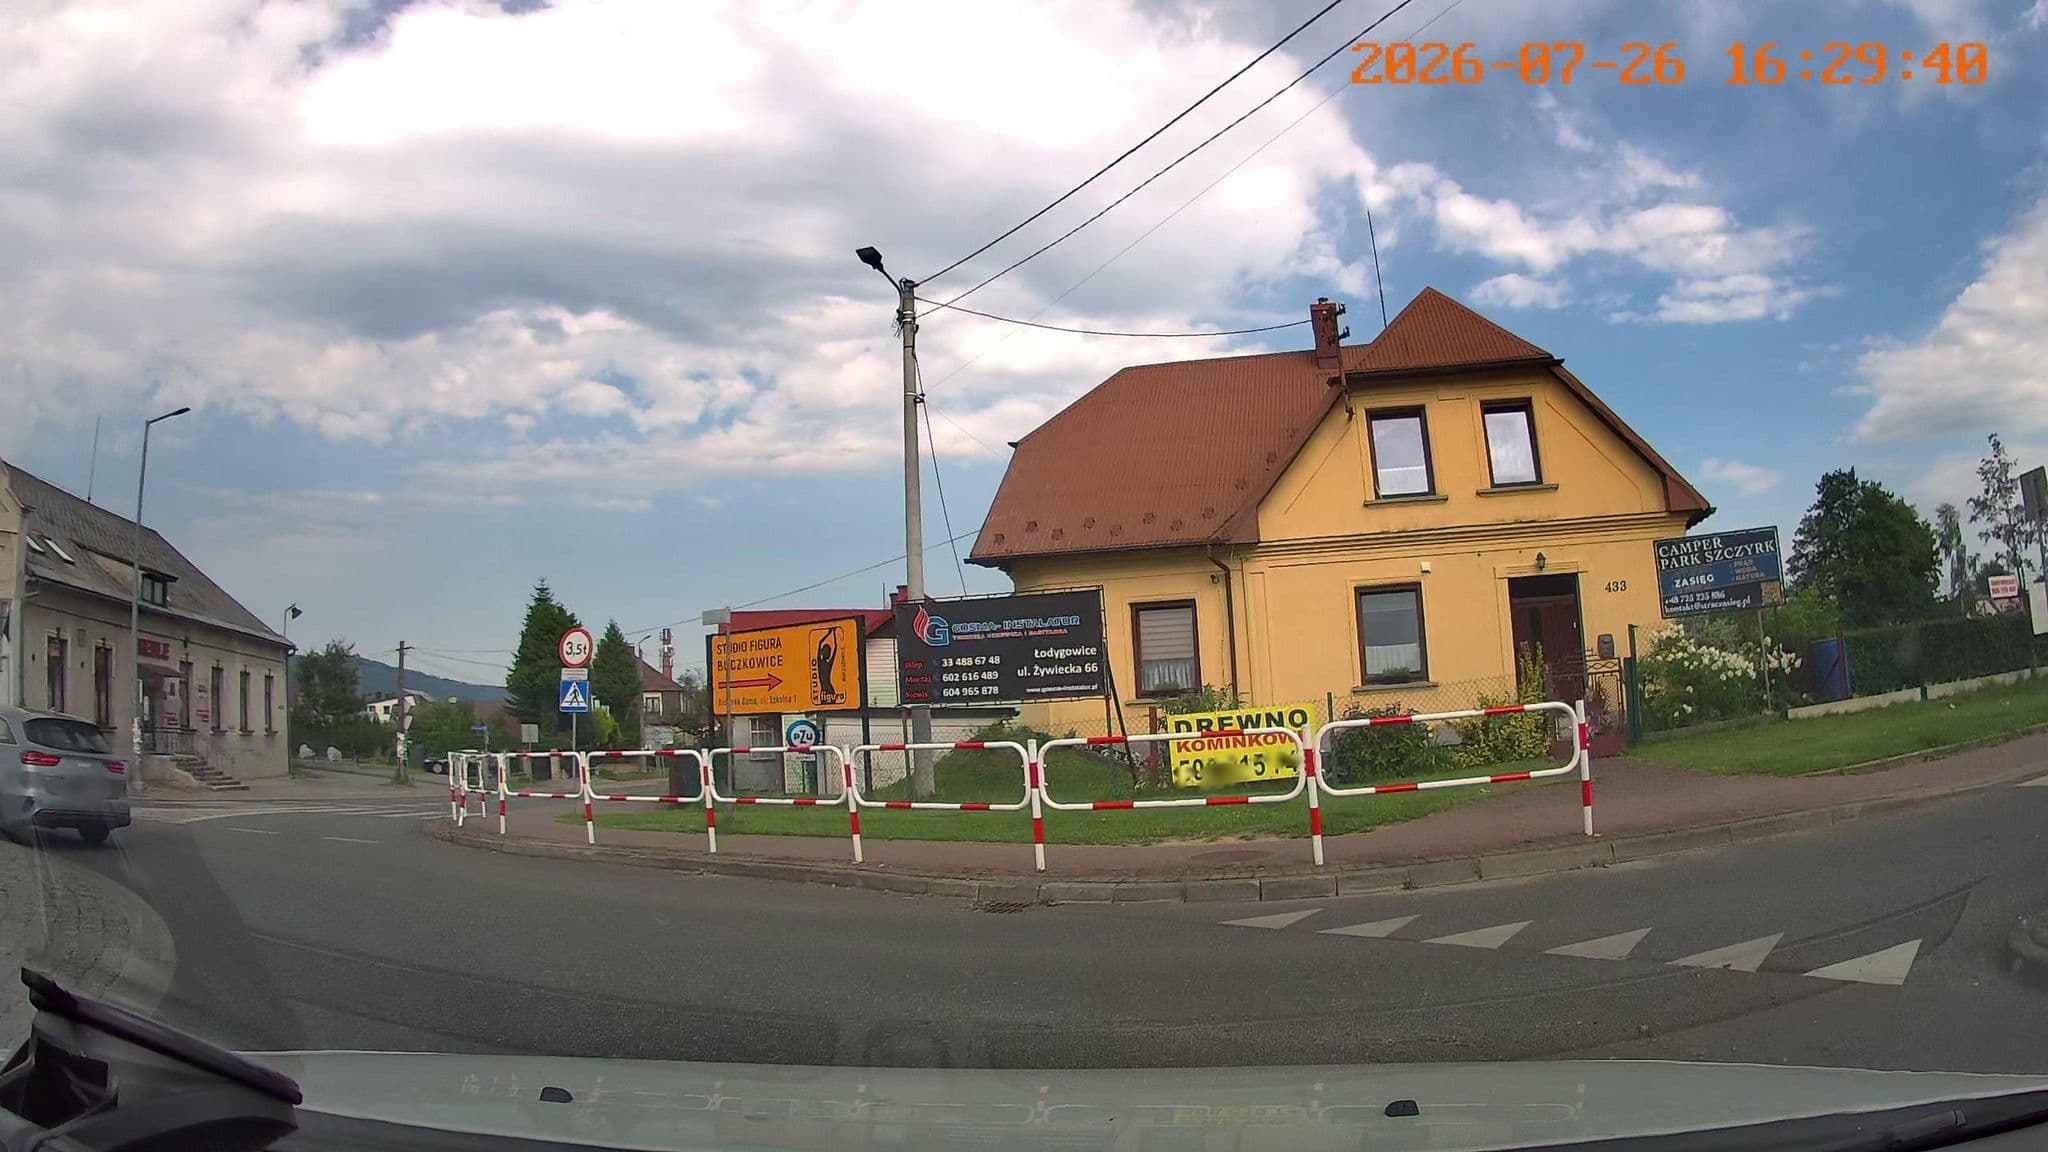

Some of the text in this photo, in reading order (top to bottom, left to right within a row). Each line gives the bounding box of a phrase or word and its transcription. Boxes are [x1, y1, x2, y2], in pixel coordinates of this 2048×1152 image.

[1659, 537, 1722, 558] CAMPER
[1660, 540, 1776, 570] PARK SZCZYRK
[1605, 580, 1627, 592] 433
[750, 637, 782, 651] FIGURA
[1034, 645, 1097, 659] Łodygowice
[941, 658, 953, 667] 33
[955, 657, 973, 666] 488
[974, 656, 986, 665] 67
[988, 656, 1000, 664] 48
[942, 673, 960, 682] 602
[961, 672, 979, 681] 616
[981, 671, 999, 679] 489
[1017, 663, 1098, 677] ul. Żywiecka 66
[811, 658, 819, 702] STUDIO
[943, 688, 960, 697] 604
[961, 687, 979, 696] 965
[981, 686, 999, 695] 878
[1176, 731, 1303, 754] KOMINKOW
